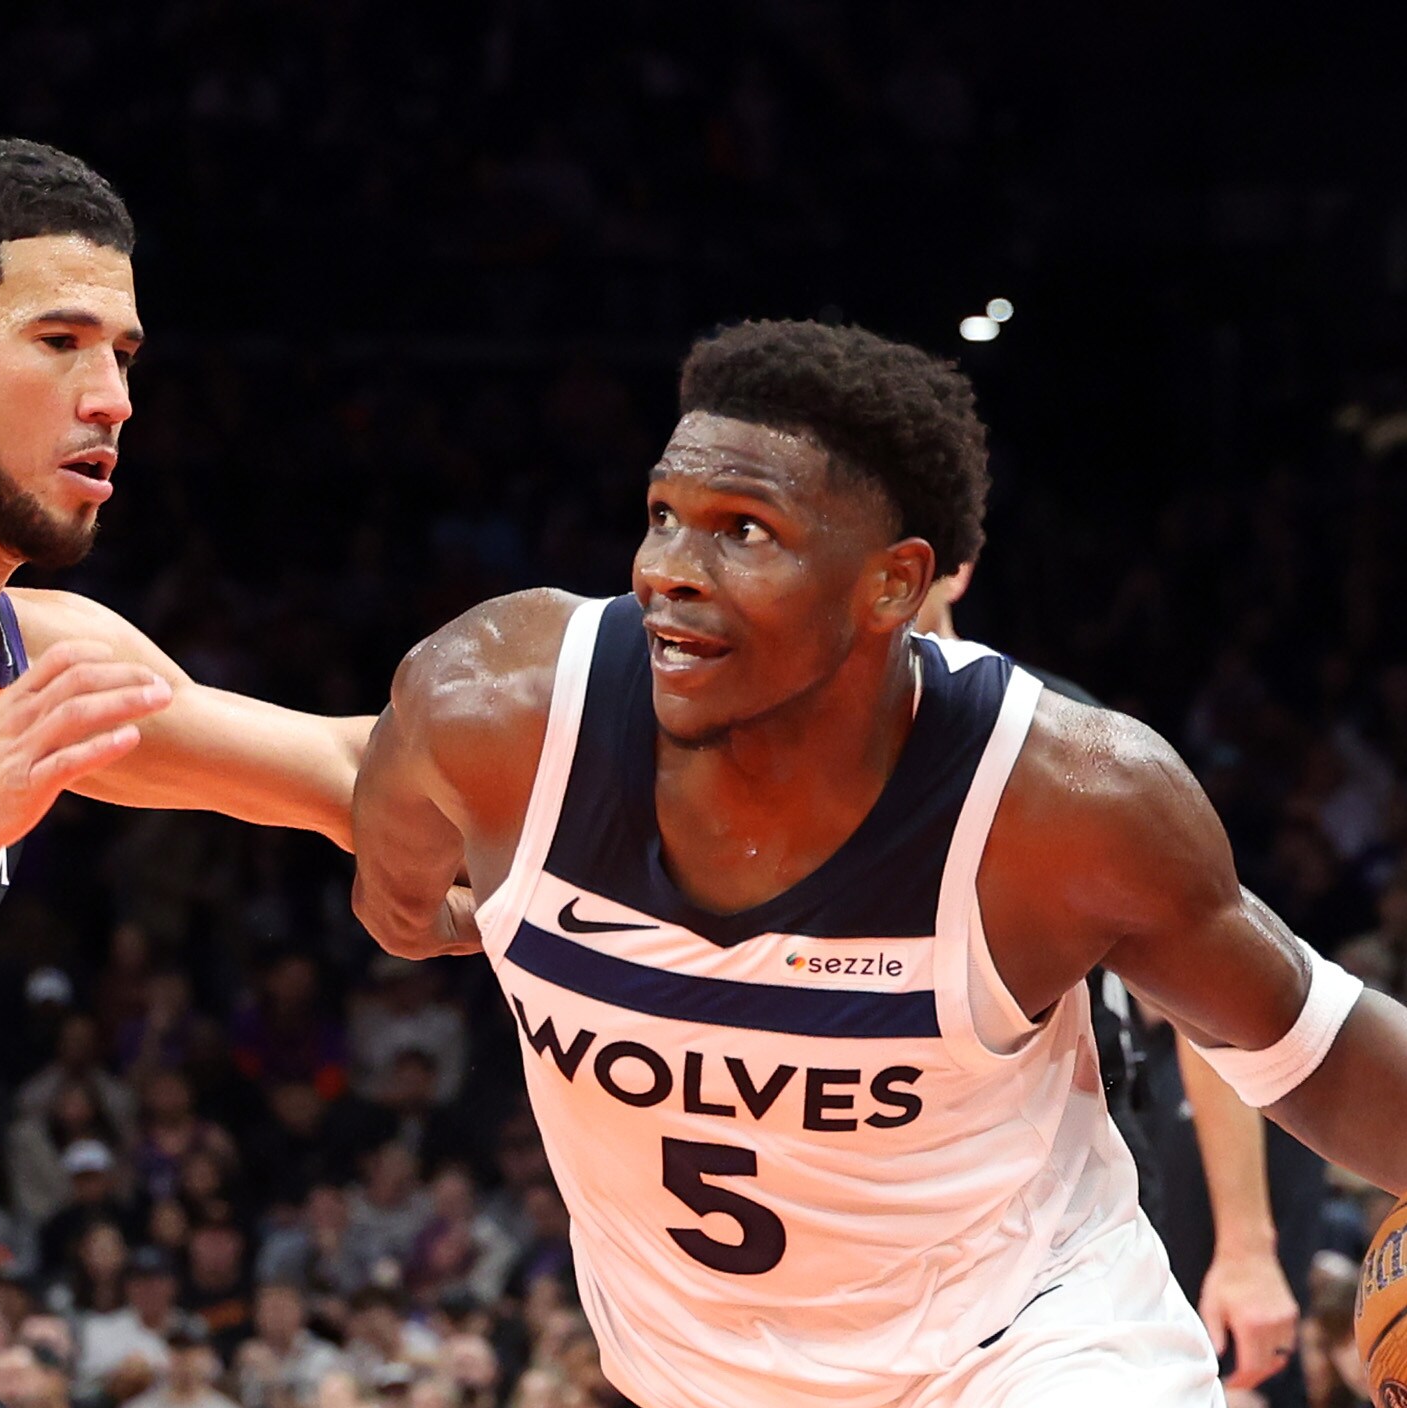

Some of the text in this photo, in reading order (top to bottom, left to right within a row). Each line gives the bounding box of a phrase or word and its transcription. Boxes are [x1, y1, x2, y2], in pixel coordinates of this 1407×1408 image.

[807, 953, 903, 977] sezzle
[512, 993, 924, 1132] WOLVES
[661, 1136, 787, 1275] 5
